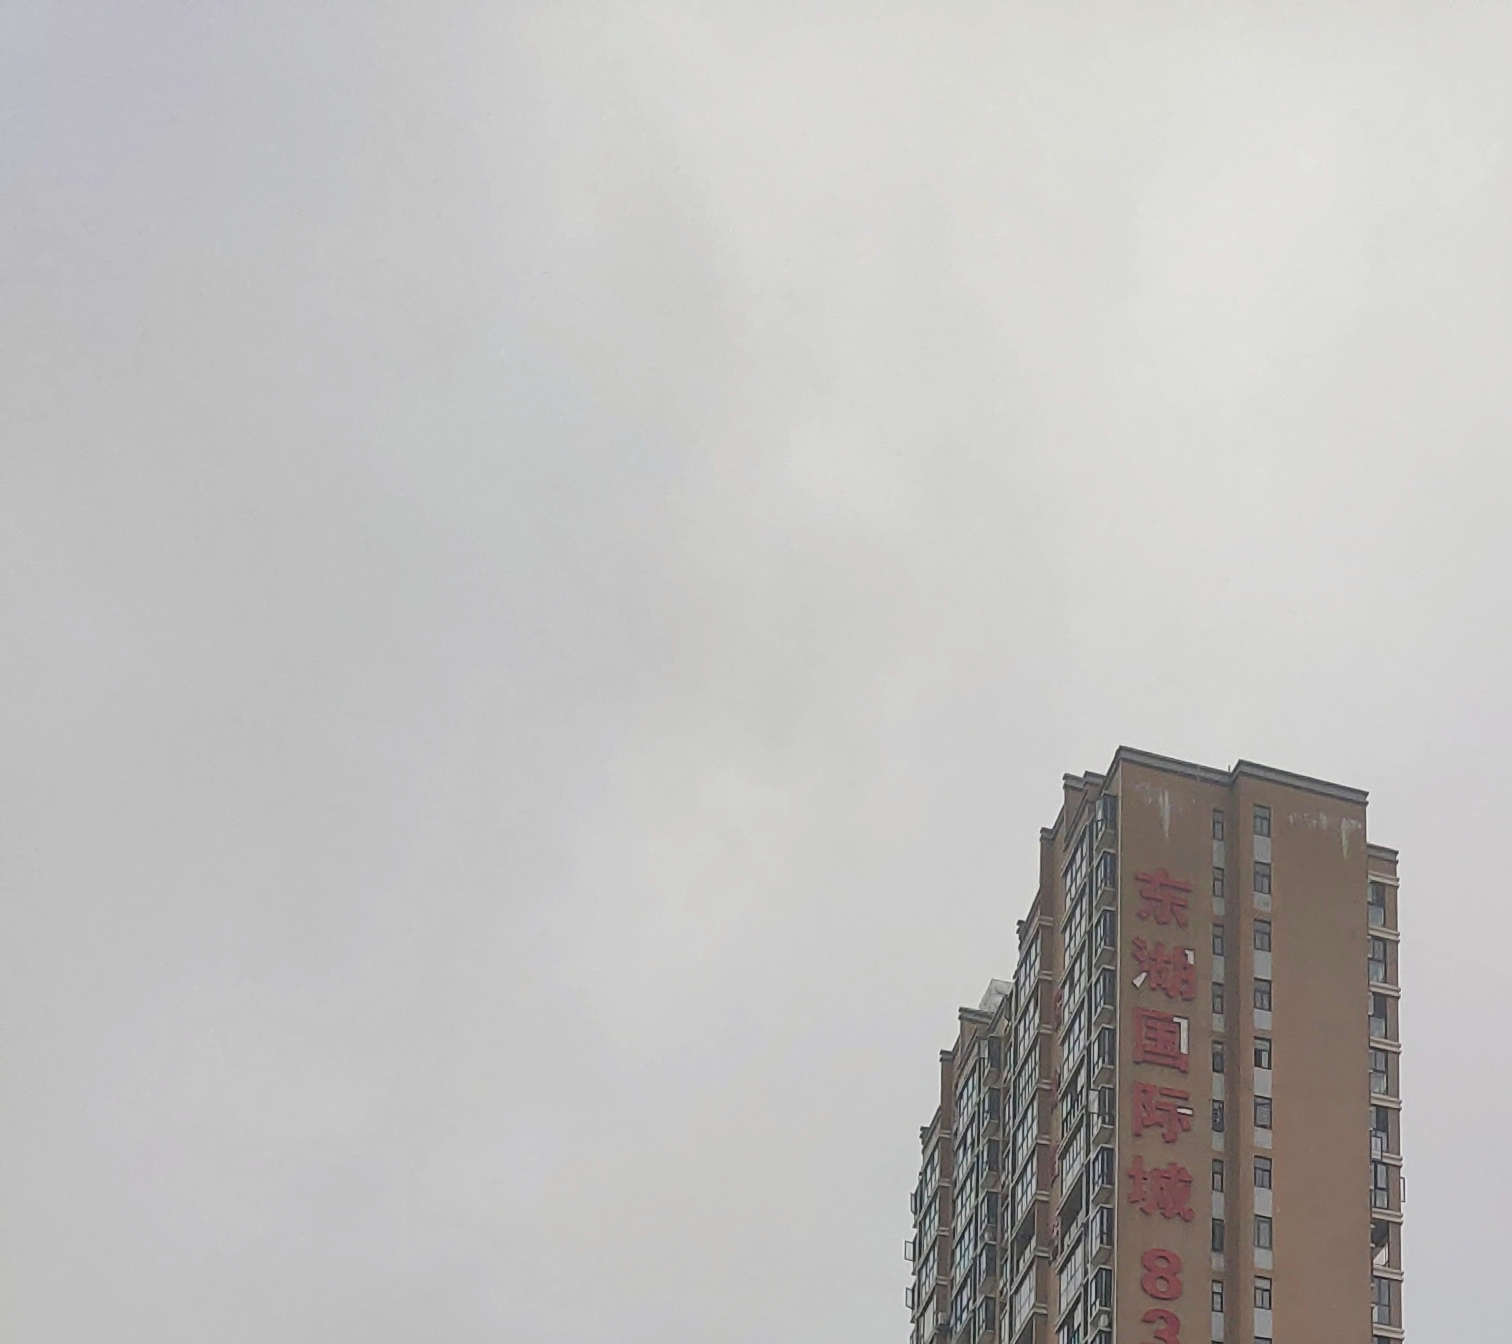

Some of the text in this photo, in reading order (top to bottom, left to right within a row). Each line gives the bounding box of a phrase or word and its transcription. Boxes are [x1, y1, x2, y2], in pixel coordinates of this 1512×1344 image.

[1127, 866, 1197, 1223] 东湖国际城
